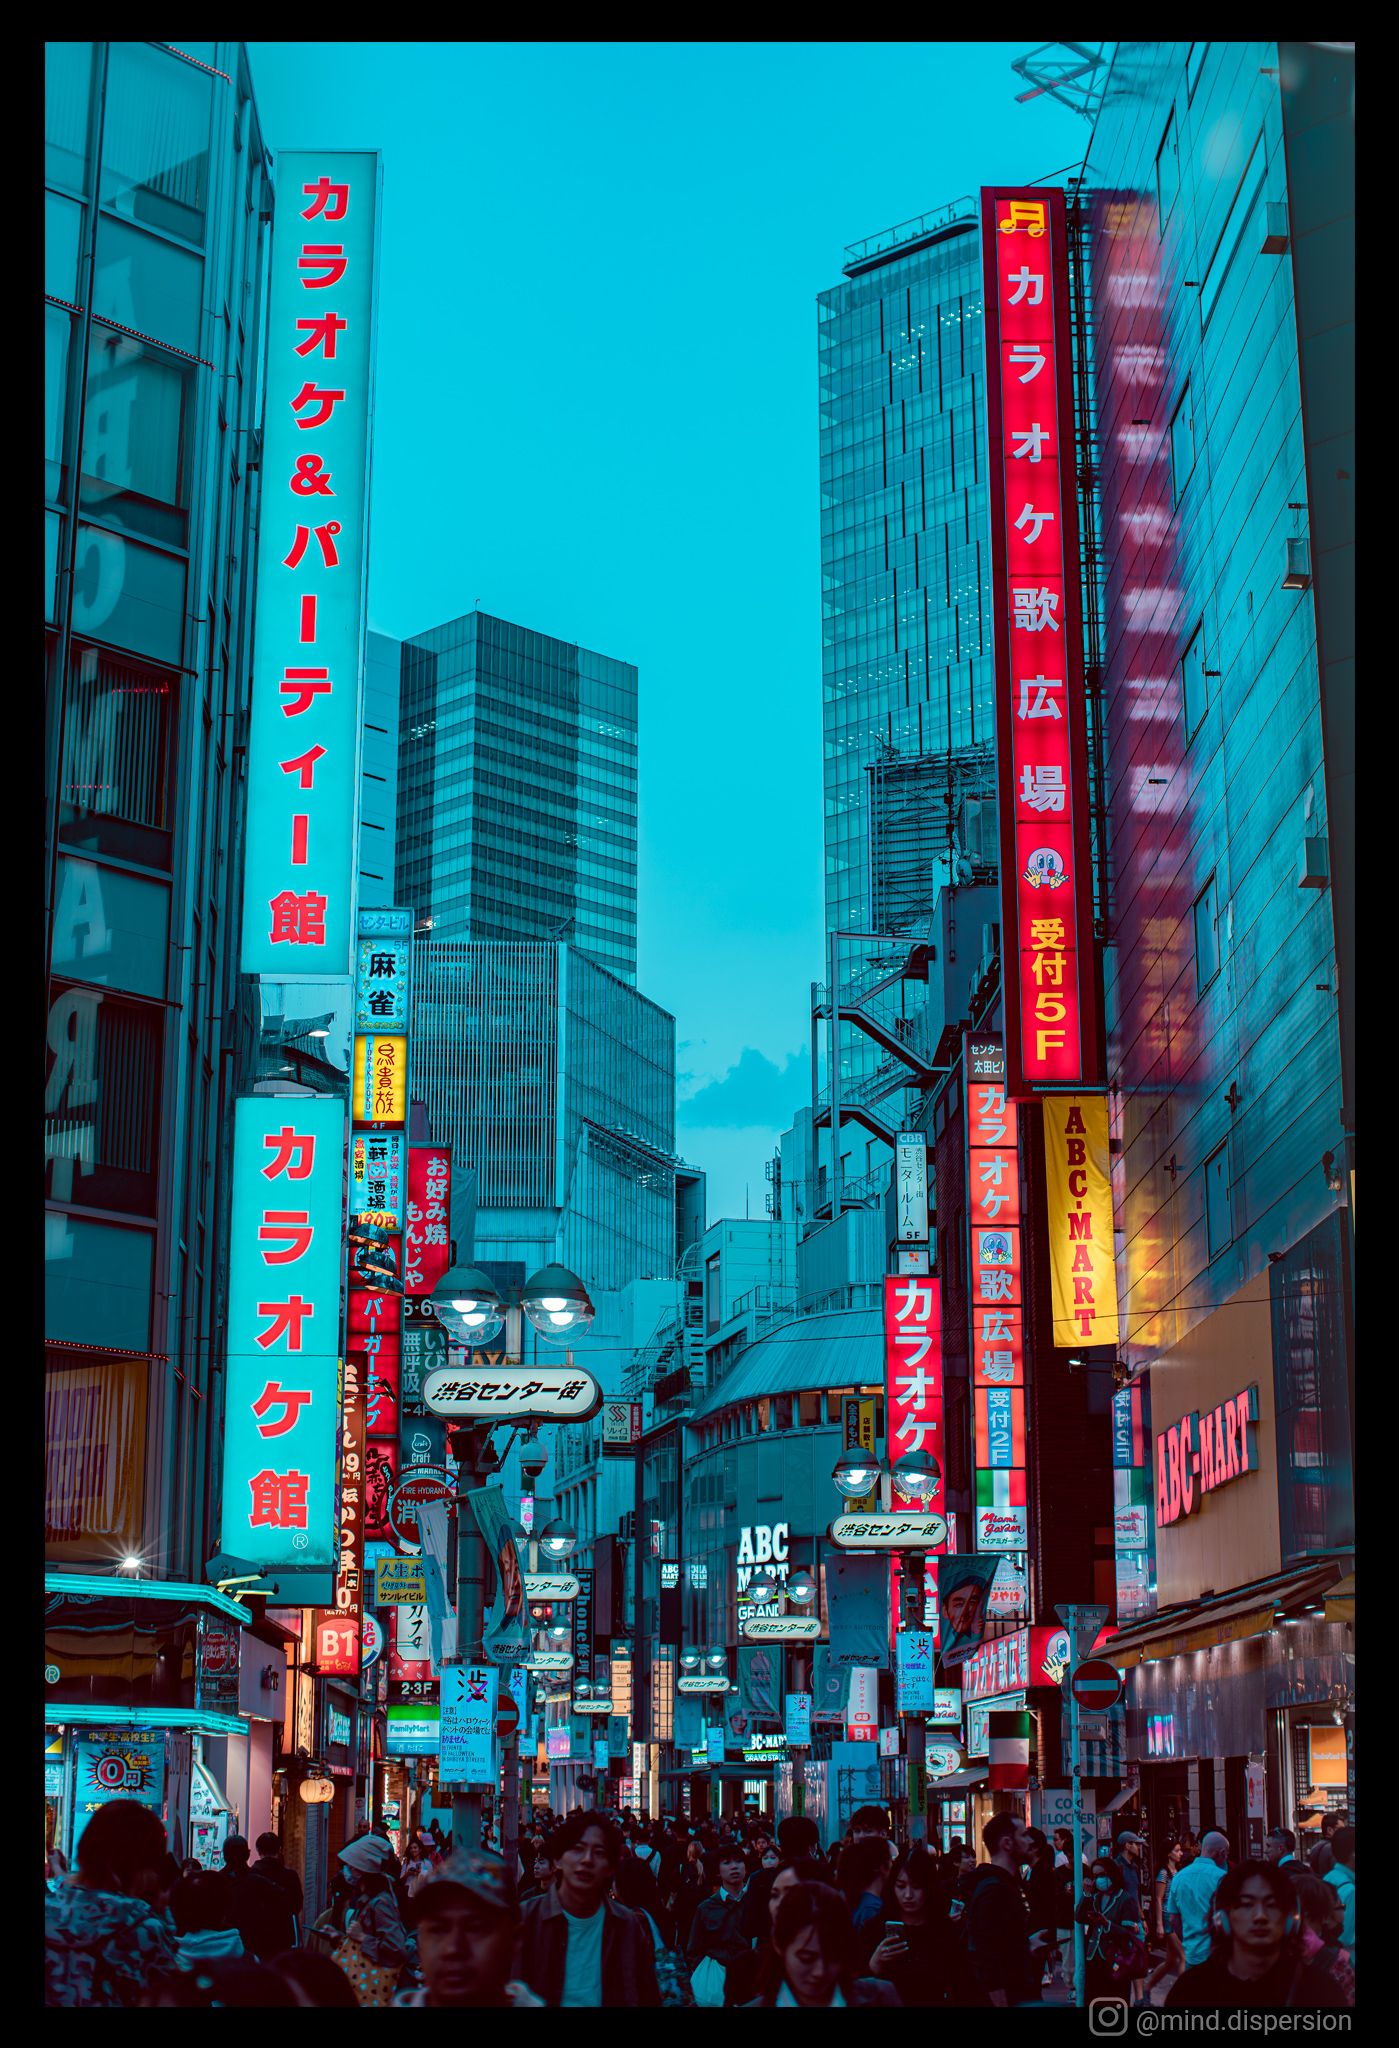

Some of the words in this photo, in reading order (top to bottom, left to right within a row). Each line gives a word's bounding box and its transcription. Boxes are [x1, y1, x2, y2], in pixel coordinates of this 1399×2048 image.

[1008, 266, 1066, 812] カラオケ歌広場
[369, 952, 396, 1016] 麻雀
[1031, 918, 1067, 1060] 受付5F
[372, 1122, 386, 1130] 4F
[978, 1087, 1009, 1218] カラオケ
[425, 1157, 448, 1245] お好み焼
[901, 1147, 913, 1227] モニタールーム
[406, 1201, 424, 1287] もんじゃ
[906, 1231, 921, 1240] 5F
[247, 1125, 317, 1529] カラオケ館
[980, 1270, 1016, 1383] 歌広場
[894, 1279, 937, 1453] カラオケ
[432, 1380, 587, 1401] 渋谷センター街
[989, 1391, 1011, 1465] 受付2F
[411, 1453, 430, 1463] Craft
[1157, 1388, 1250, 1529] ABC-MART
[417, 1487, 447, 1495] HYDRANT
[838, 1522, 941, 1537] 渋谷センター街
[980, 1513, 1018, 1523] Miami
[737, 1523, 789, 1565] ABC
[661, 1564, 679, 1573] ABC
[380, 1592, 424, 1601] サンルイビル
[322, 1630, 354, 1657] B1
[389, 1724, 430, 1734] FamilyMart
[854, 1728, 872, 1740] B1
